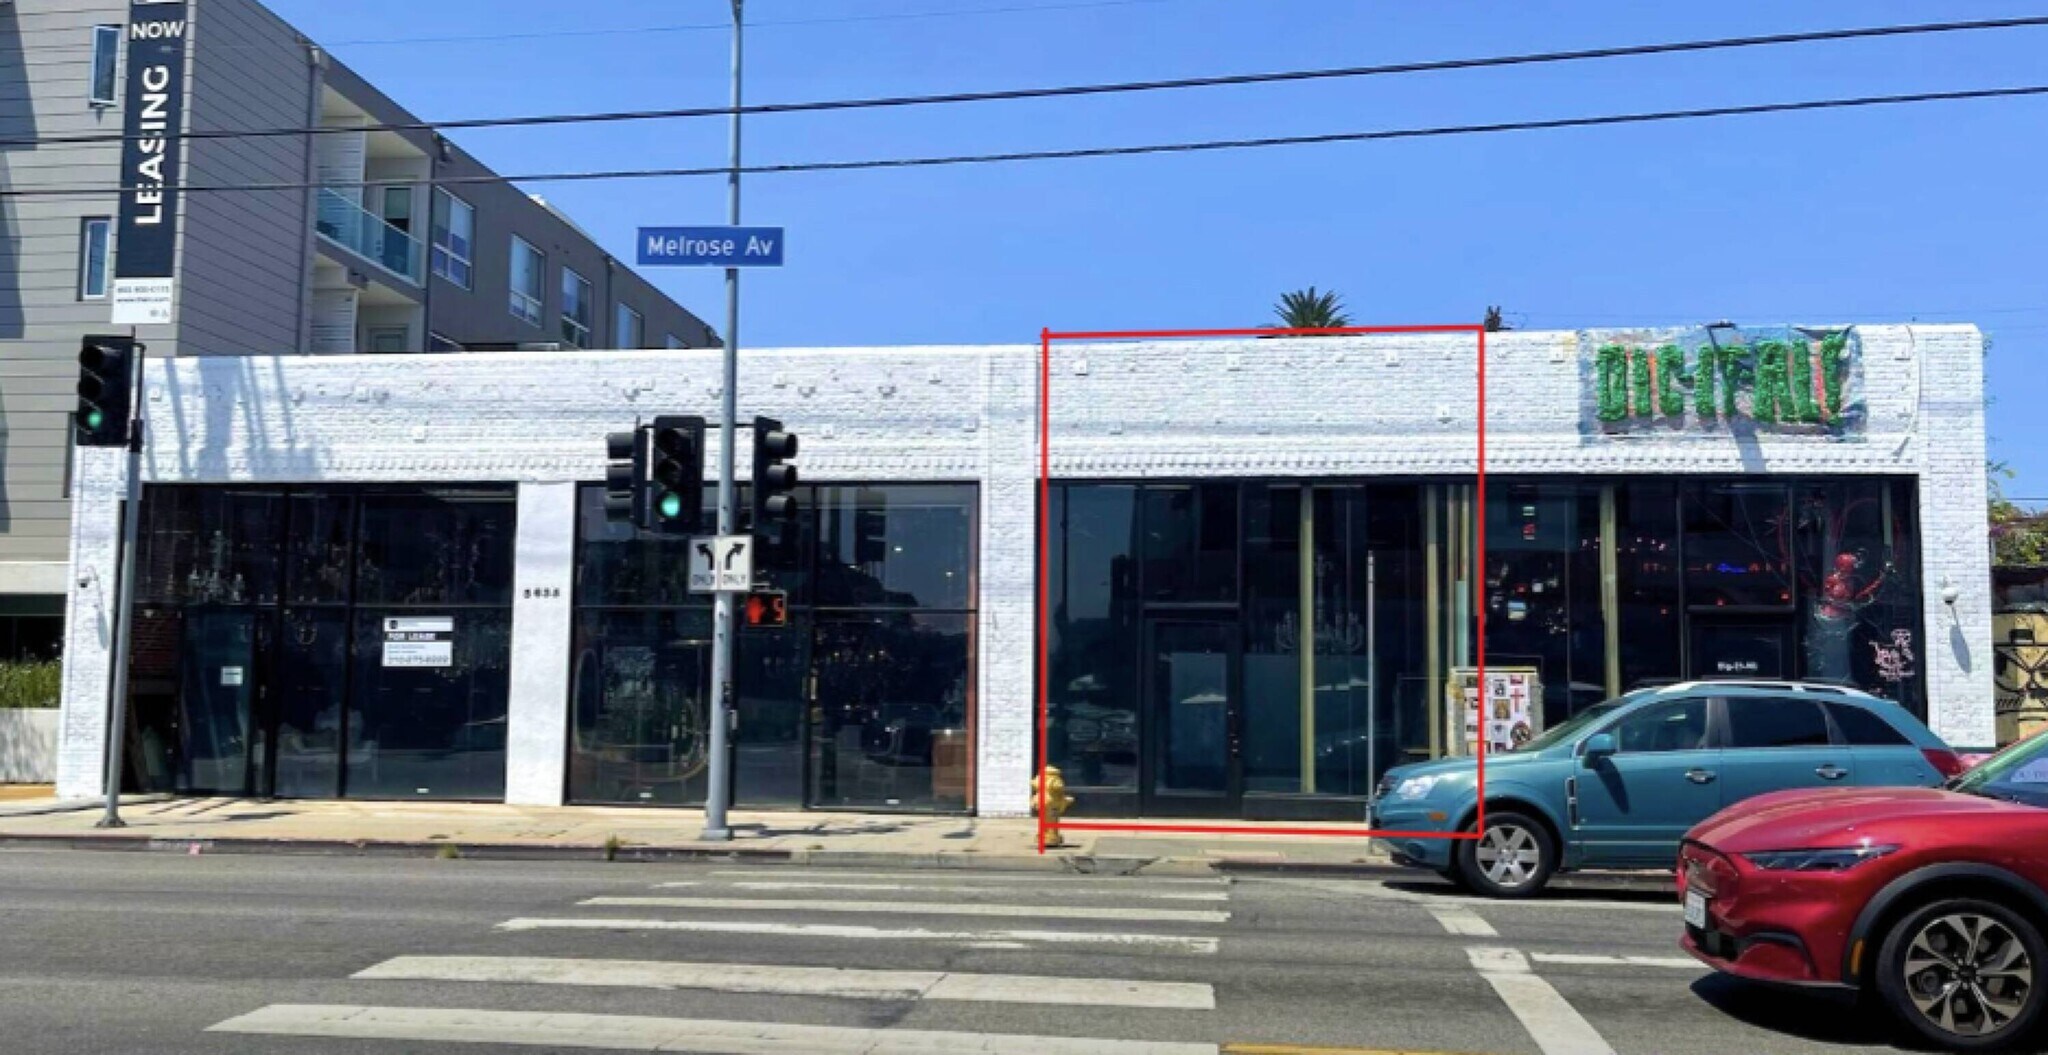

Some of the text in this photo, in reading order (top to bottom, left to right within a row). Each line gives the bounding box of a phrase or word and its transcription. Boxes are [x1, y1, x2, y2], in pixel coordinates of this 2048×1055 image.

[131, 21, 184, 39] NOW
[134, 65, 169, 225] LEASING
[647, 235, 773, 256] Melrose Av
